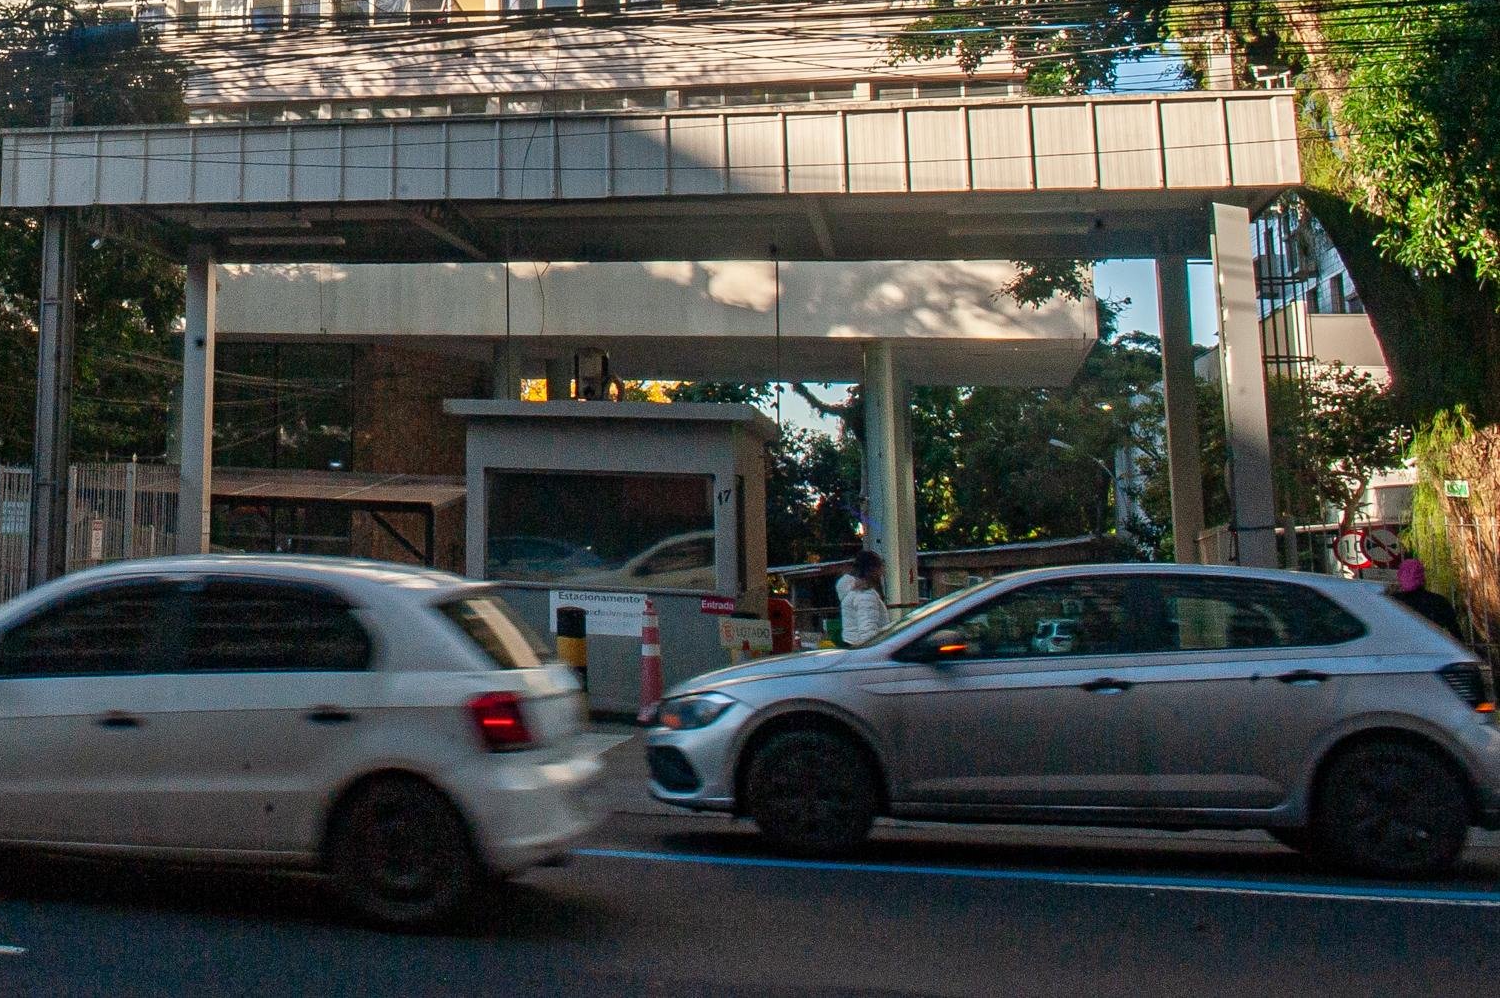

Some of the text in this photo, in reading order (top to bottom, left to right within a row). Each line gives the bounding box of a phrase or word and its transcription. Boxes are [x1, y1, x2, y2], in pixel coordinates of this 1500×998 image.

[717, 488, 732, 506] 17
[558, 590, 641, 604] Estacionamento
[701, 599, 734, 611] Entrada
